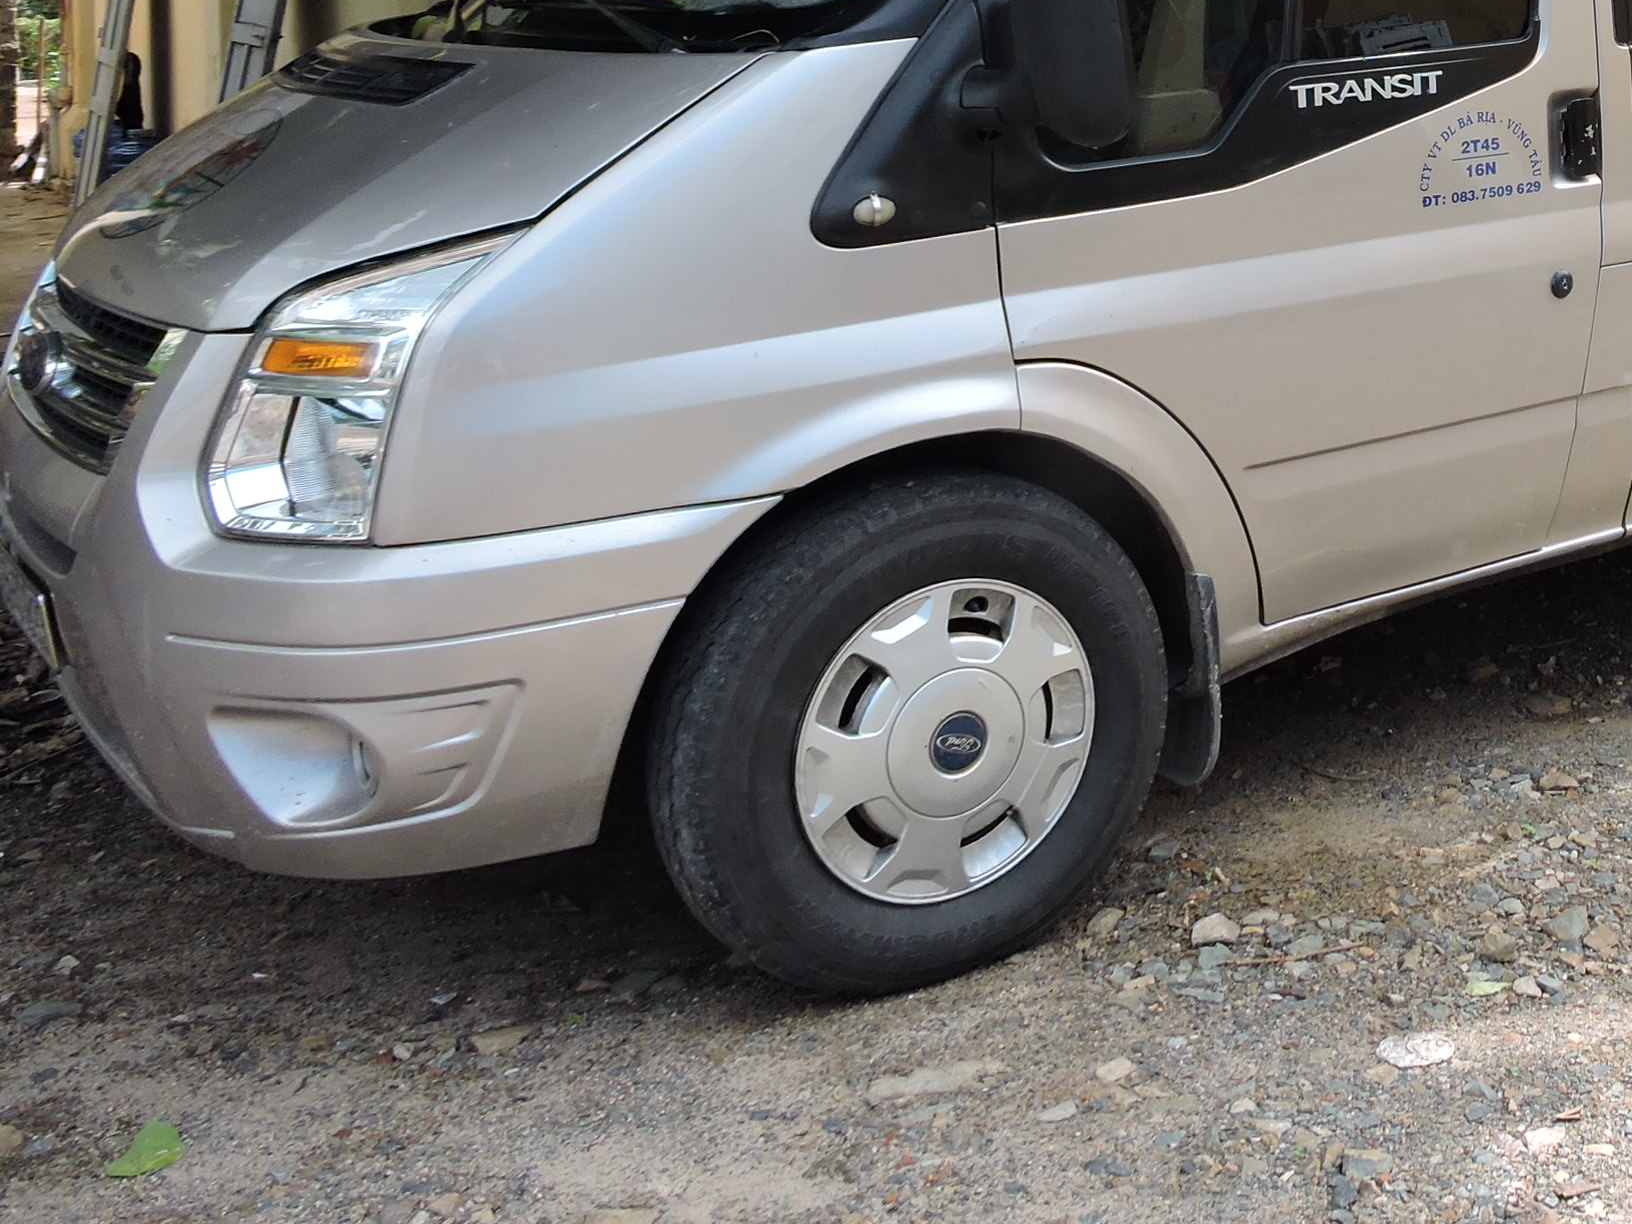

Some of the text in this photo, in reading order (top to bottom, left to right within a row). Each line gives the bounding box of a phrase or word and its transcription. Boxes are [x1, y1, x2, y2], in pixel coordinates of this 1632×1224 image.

[1288, 70, 1444, 109] TRANSIT
[1461, 137, 1500, 155] 2T45
[1420, 163, 1433, 192] CTY
[1427, 141, 1442, 159] VT
[1440, 125, 1457, 143] DL
[1466, 161, 1497, 178] 16N
[1422, 180, 1542, 208] ĐT: 083.7509 629
[945, 736, 974, 752] Ford
